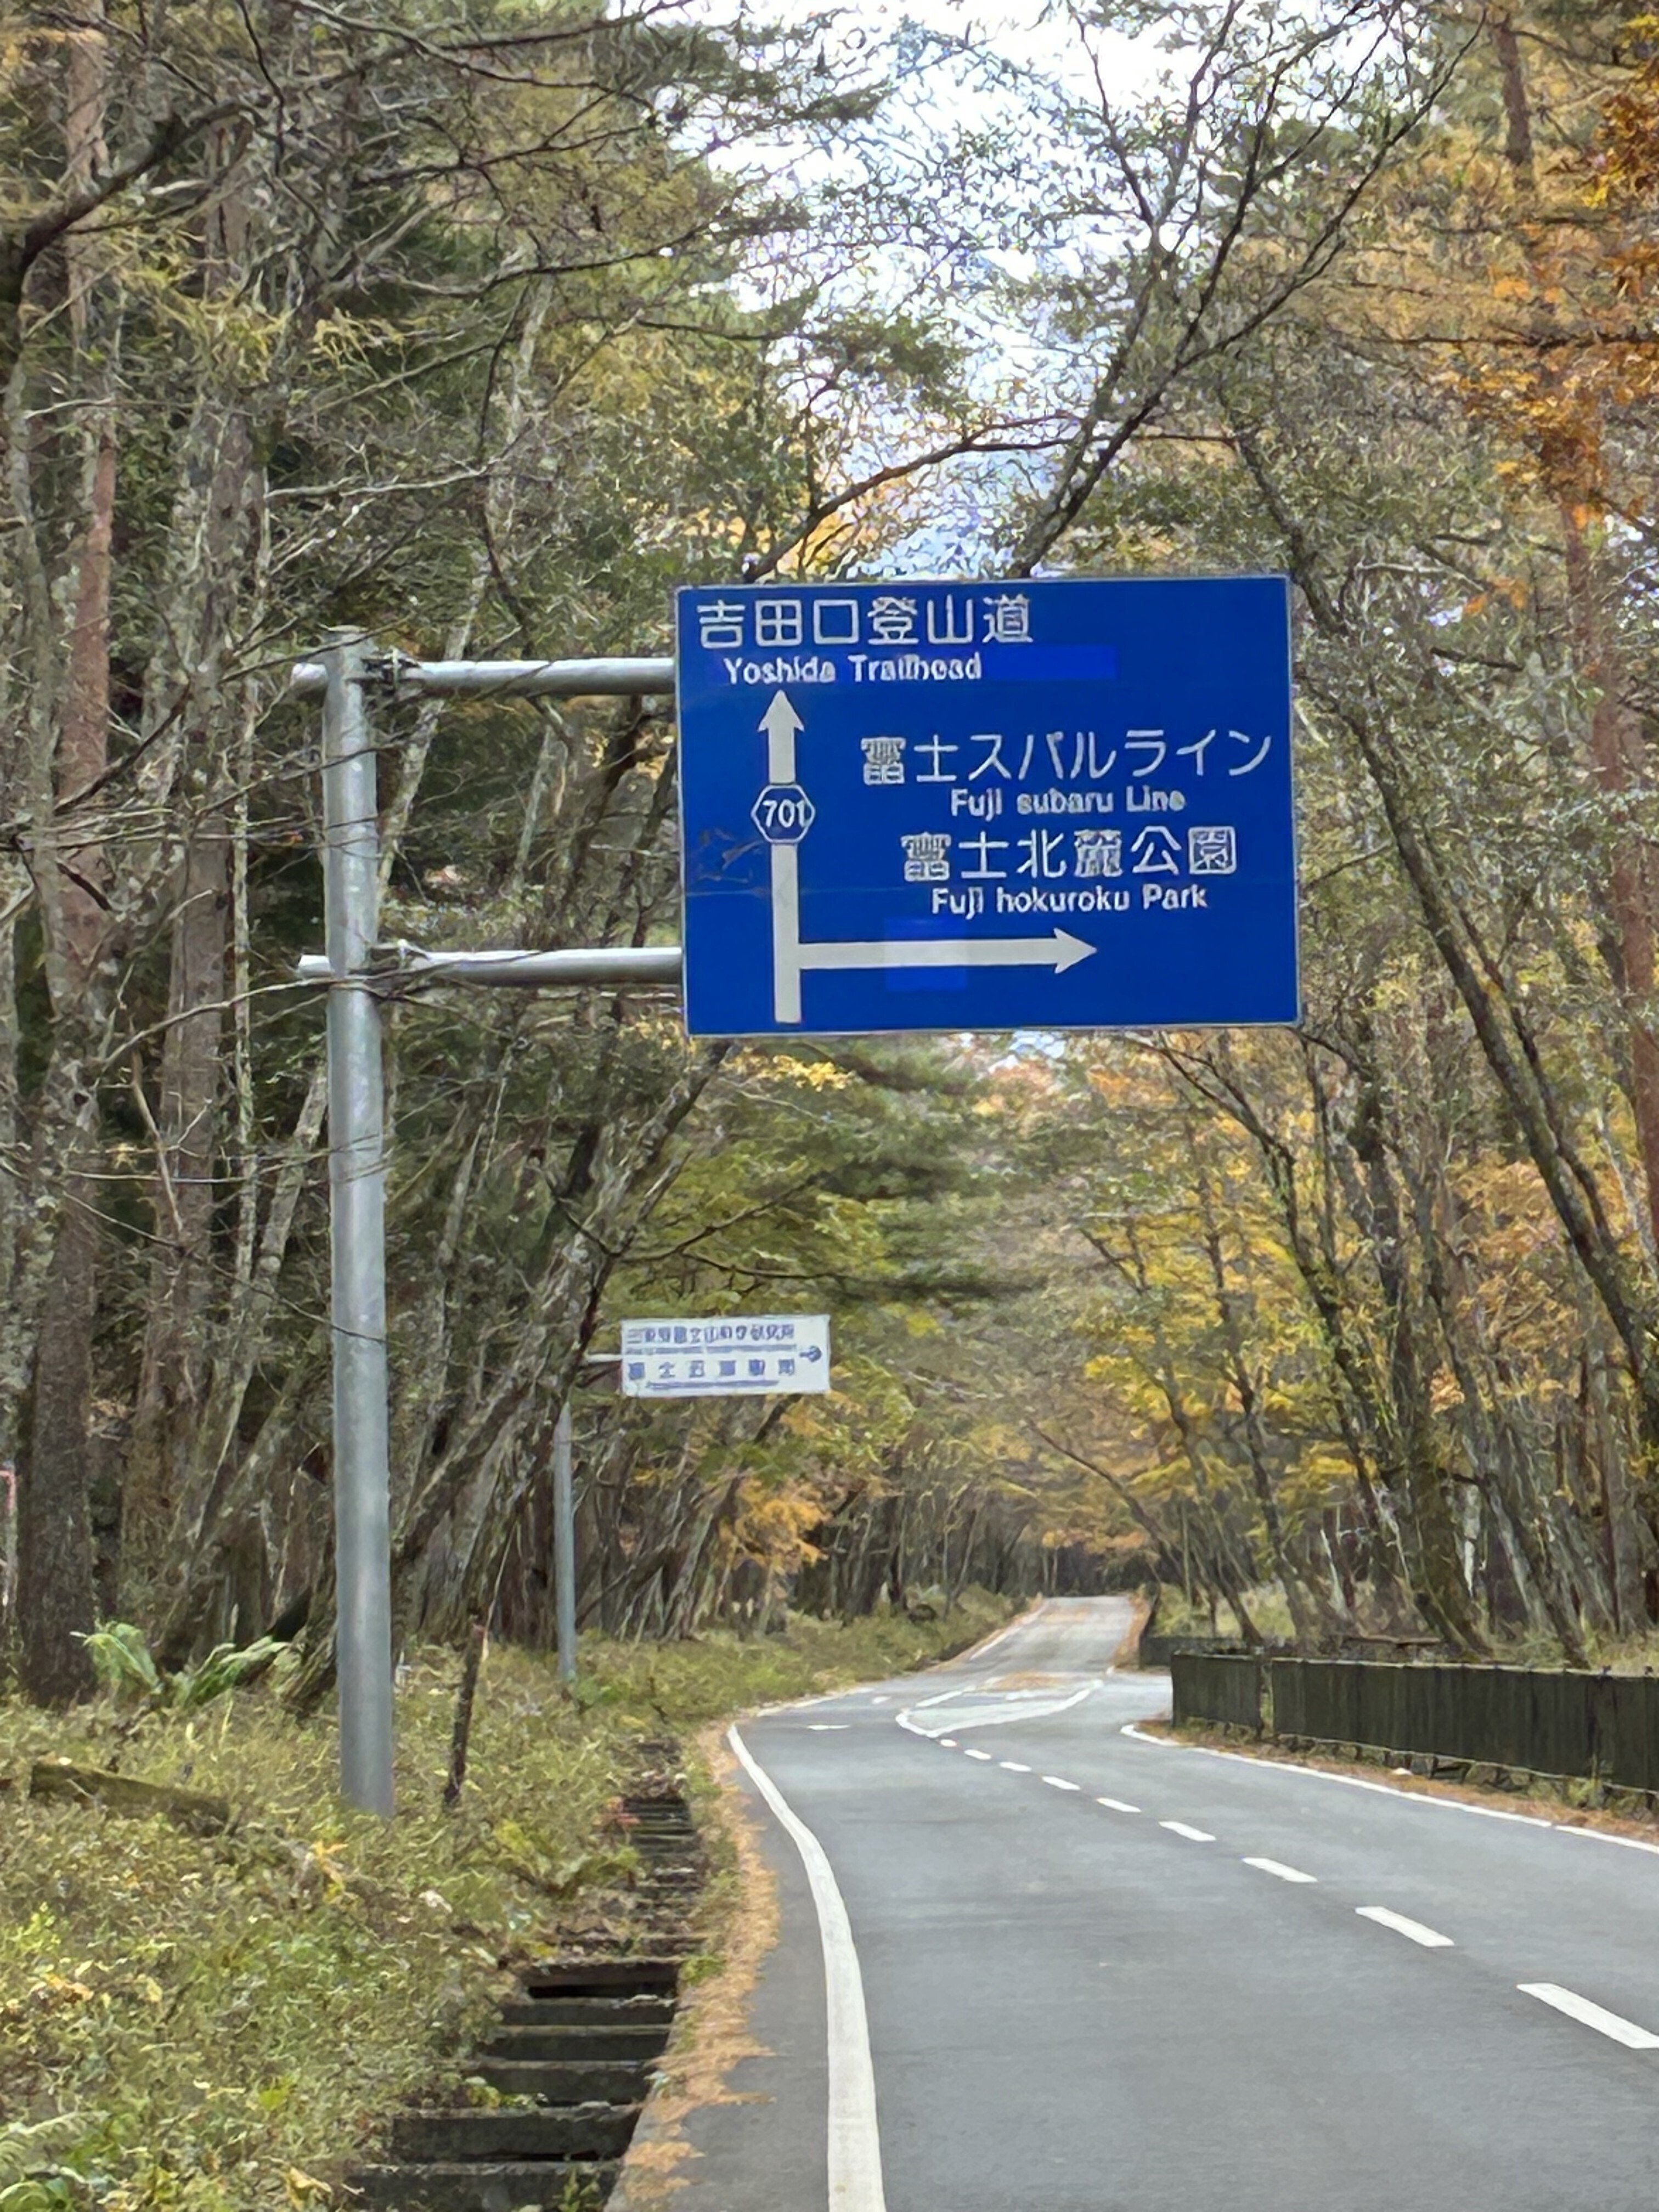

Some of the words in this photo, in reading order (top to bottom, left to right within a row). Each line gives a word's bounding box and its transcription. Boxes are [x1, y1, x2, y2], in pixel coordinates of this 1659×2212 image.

[697, 595, 1034, 649] 吉田口登山道
[724, 656, 836, 684] Yoshida
[763, 798, 805, 828] 701
[951, 788, 1003, 822] Fuji
[932, 887, 984, 920] Fuji
[996, 884, 1130, 913] hokuroku
[1142, 883, 1209, 911] Park
